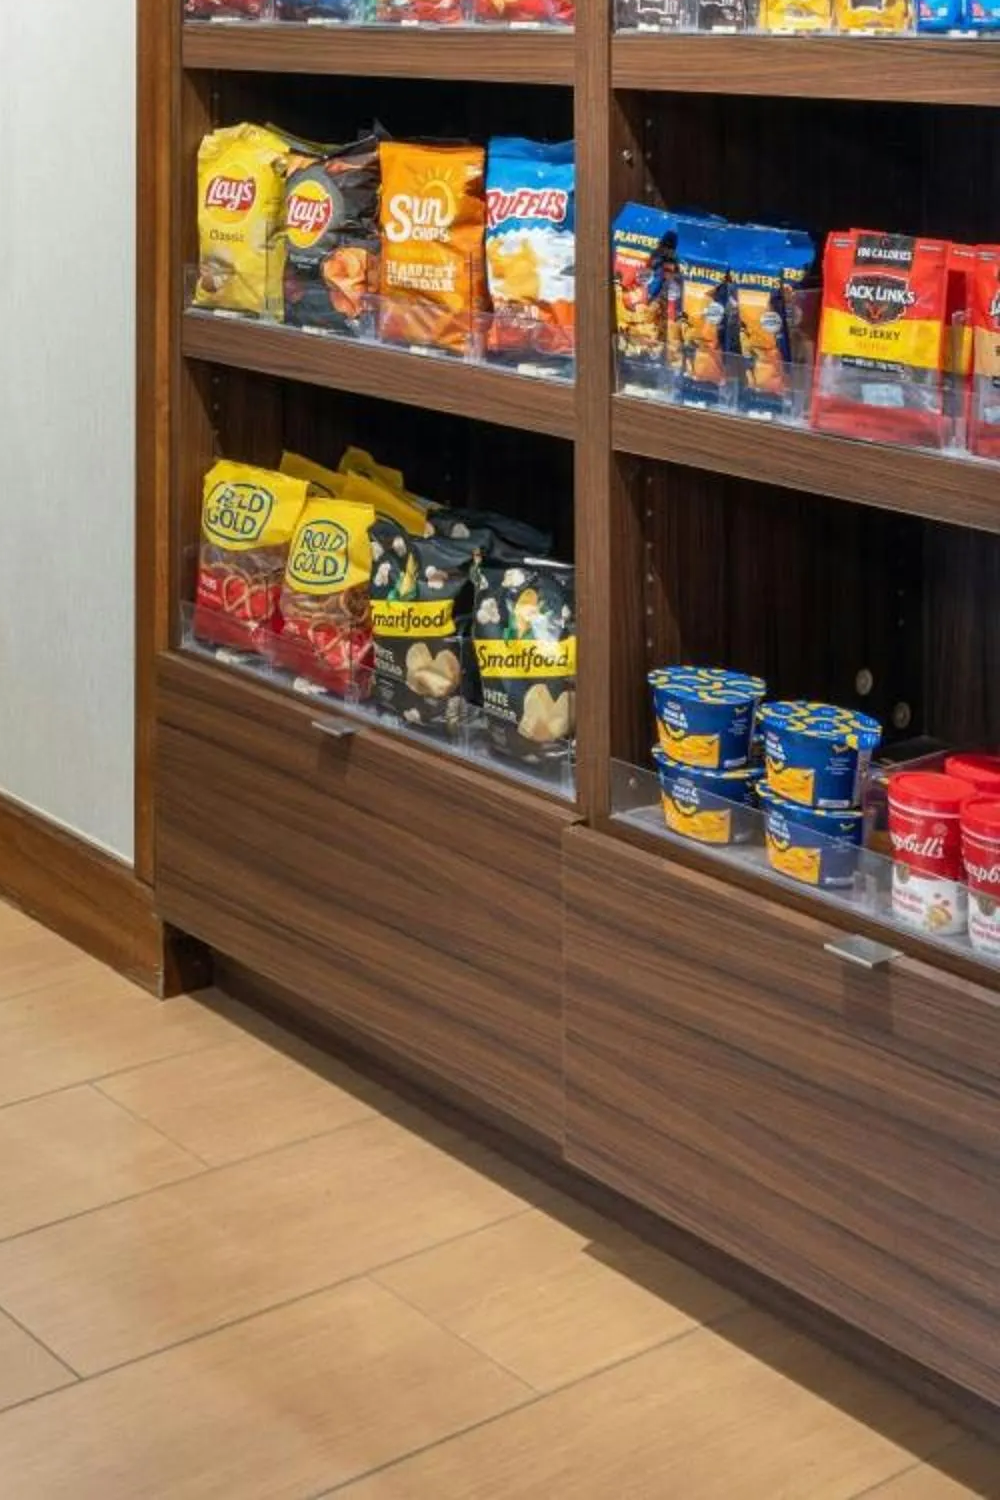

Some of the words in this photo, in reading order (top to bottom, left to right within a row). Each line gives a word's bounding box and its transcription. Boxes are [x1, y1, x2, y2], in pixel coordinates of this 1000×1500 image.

[207, 176, 255, 211] Lay's
[287, 196, 328, 231] Lay's
[487, 189, 568, 229] RUFFLES
[209, 229, 245, 242] Classic
[614, 230, 660, 249] PLANTERS
[206, 507, 257, 535] GOLD
[300, 528, 344, 554] ROLD
[293, 552, 339, 577] GOLD
[372, 604, 446, 633] martfood
